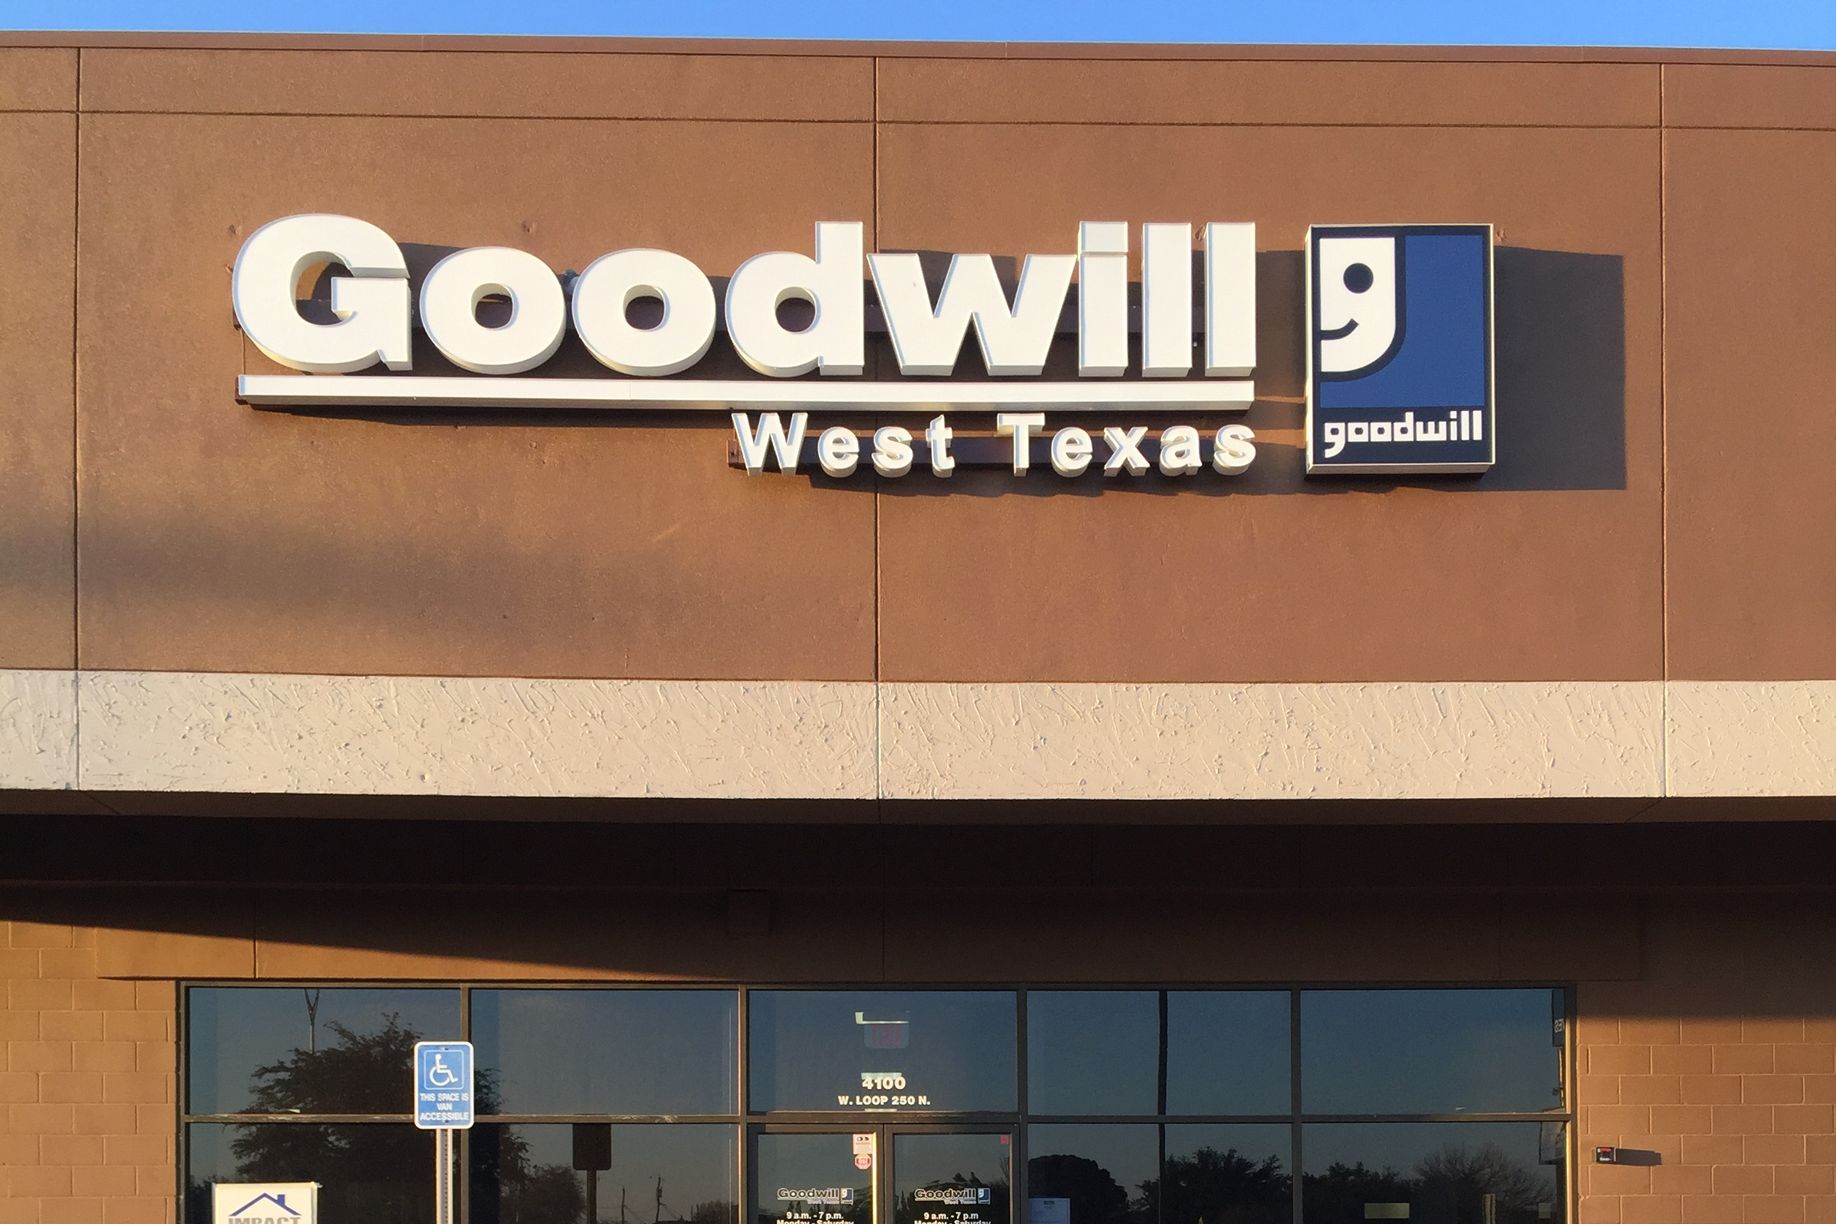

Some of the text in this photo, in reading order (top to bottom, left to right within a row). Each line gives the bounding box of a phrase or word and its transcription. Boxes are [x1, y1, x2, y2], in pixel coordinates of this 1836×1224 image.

[231, 213, 1257, 377] Goodwill
[1324, 410, 1483, 458] goodwill
[731, 412, 1257, 477] West Texas
[862, 1077, 906, 1090] 4100
[420, 1093, 469, 1101] THIS SPACE IS
[838, 1096, 931, 1105] W. LOOP 250 N.
[436, 1103, 453, 1111] VAN
[420, 1112, 469, 1121] ACCESSIBLE
[777, 1188, 840, 1199] Goodwill
[915, 1188, 977, 1199] Goodwill
[786, 1211, 792, 1219] 9
[818, 1211, 824, 1219] 7
[923, 1212, 930, 1220] 9
[955, 1212, 961, 1220] 7
